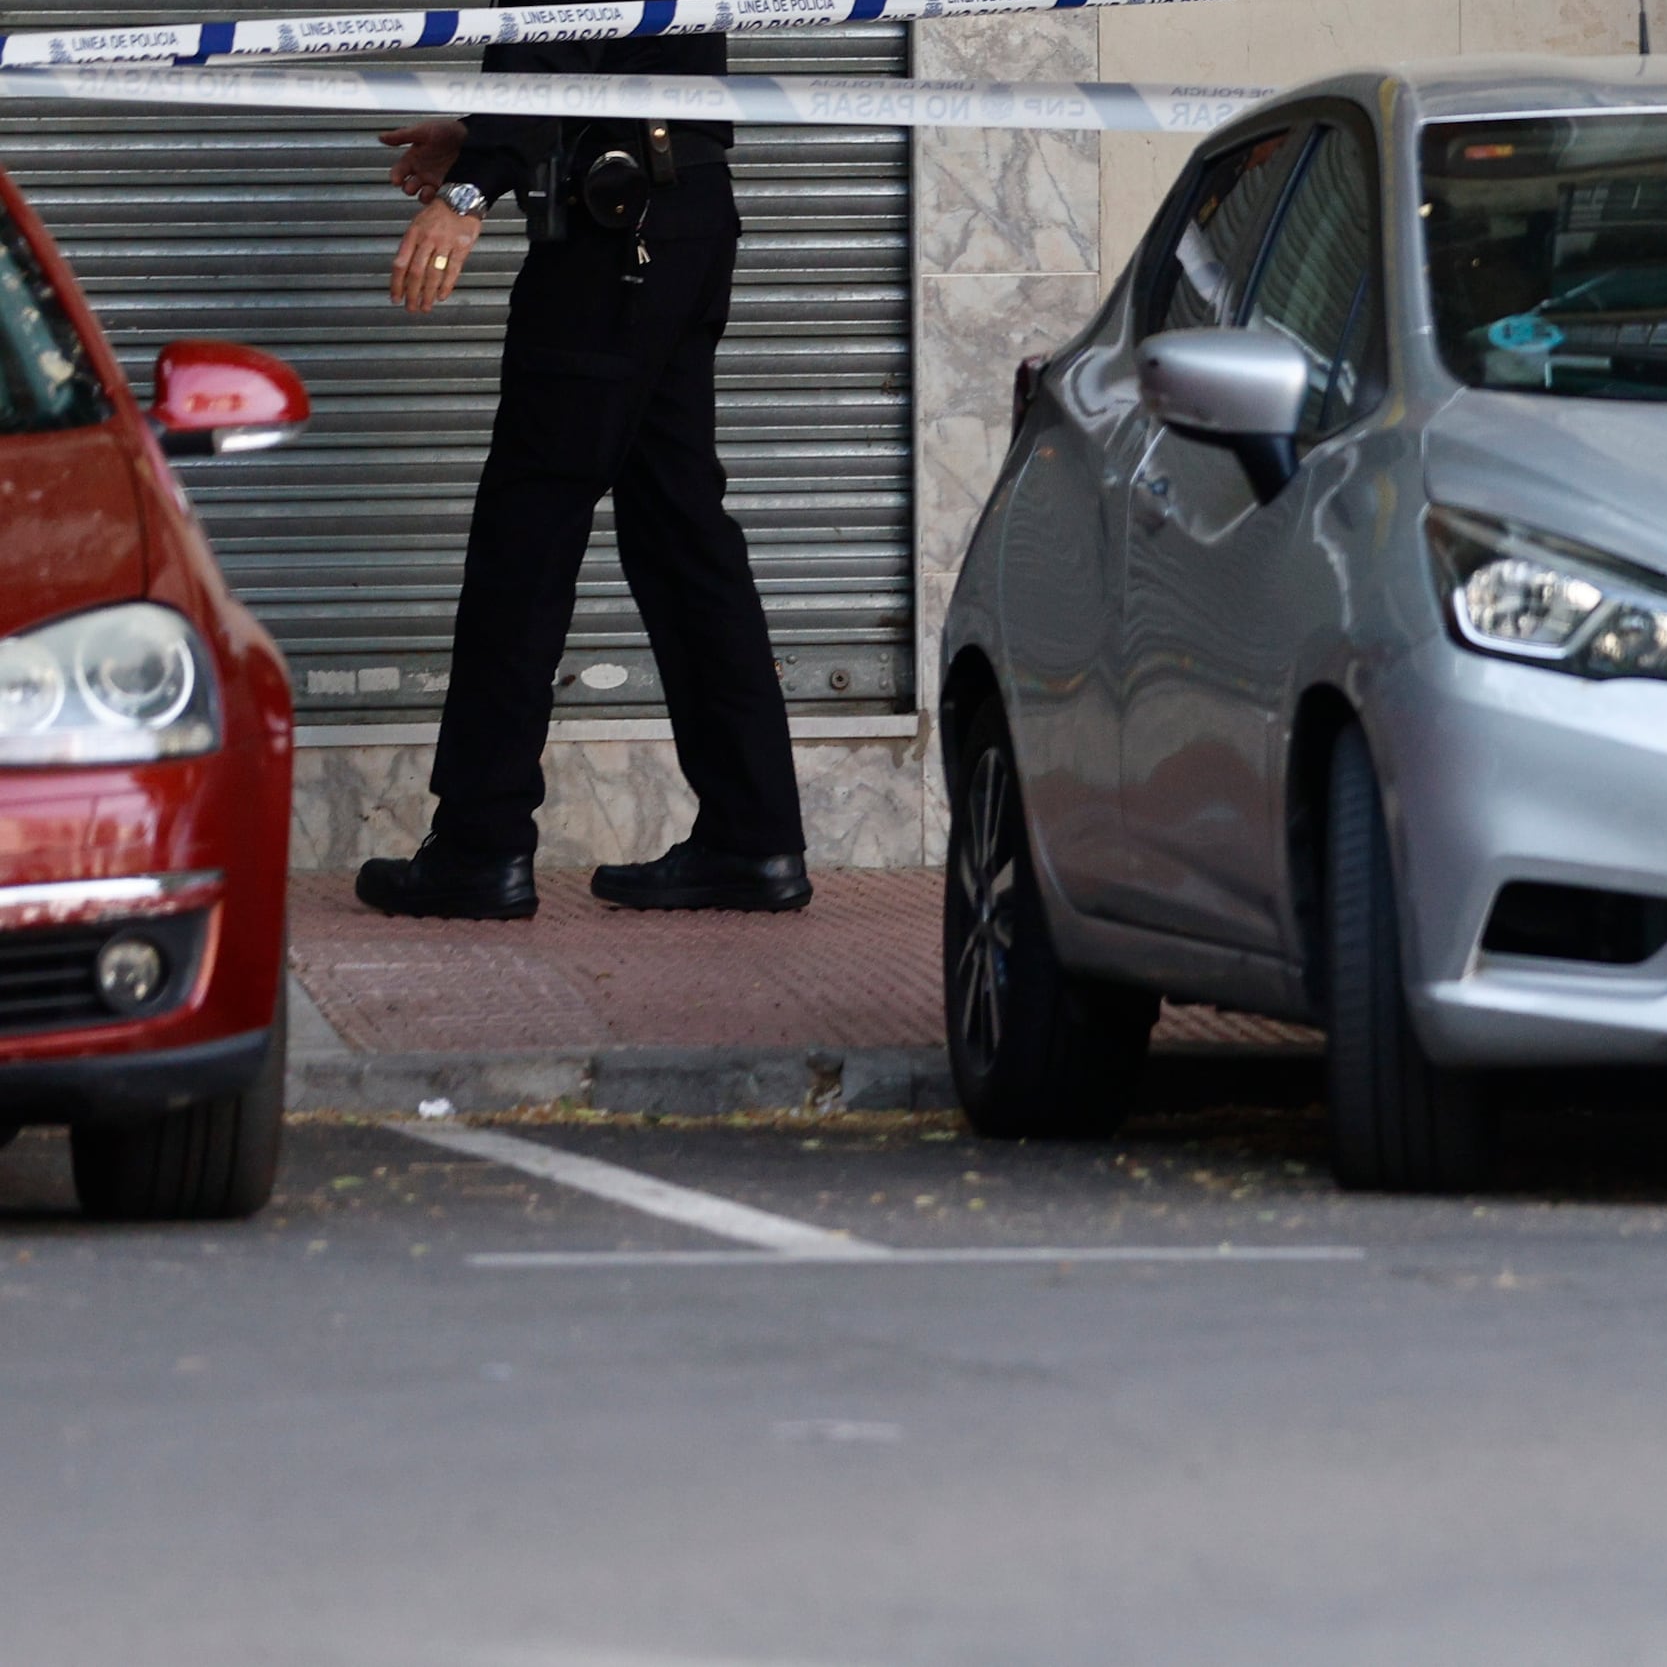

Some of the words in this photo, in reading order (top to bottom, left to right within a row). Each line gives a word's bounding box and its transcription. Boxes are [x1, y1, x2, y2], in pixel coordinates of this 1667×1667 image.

[737, 0, 770, 14] LINEA
[520, 9, 555, 25] LINEA
[557, 8, 575, 22] DE
[577, 6, 623, 21] POLICIA
